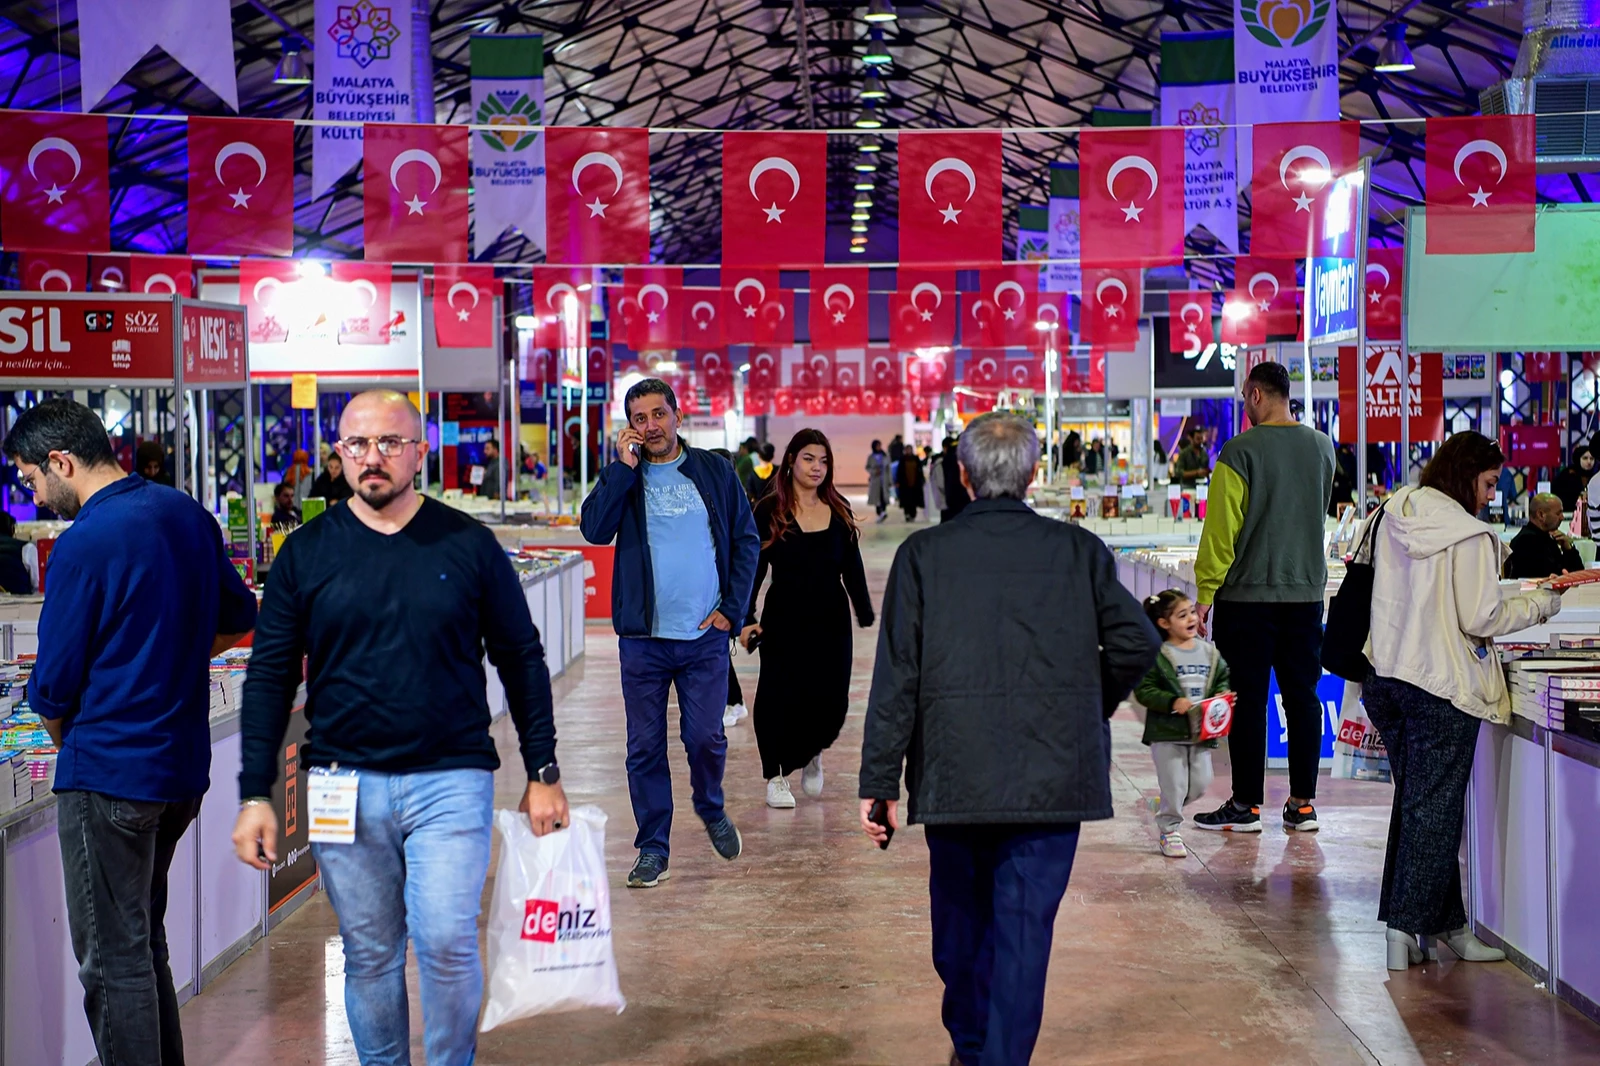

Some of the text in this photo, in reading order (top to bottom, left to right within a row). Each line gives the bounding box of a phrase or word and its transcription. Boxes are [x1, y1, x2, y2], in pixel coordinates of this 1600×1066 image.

[1265, 58, 1311, 69] MALATYA
[332, 77, 394, 88] MALATYA
[1260, 81, 1318, 94] BELEDİYESİ
[316, 88, 409, 108] BÜYÜKŞEHİR
[328, 108, 395, 120] BELEDİYESİ
[125, 309, 159, 326] SÖZ
[112, 353, 131, 362] EMA
[6, 358, 71, 371] nesiller için...
[113, 362, 130, 370] kitap
[524, 904, 596, 935] deniz
